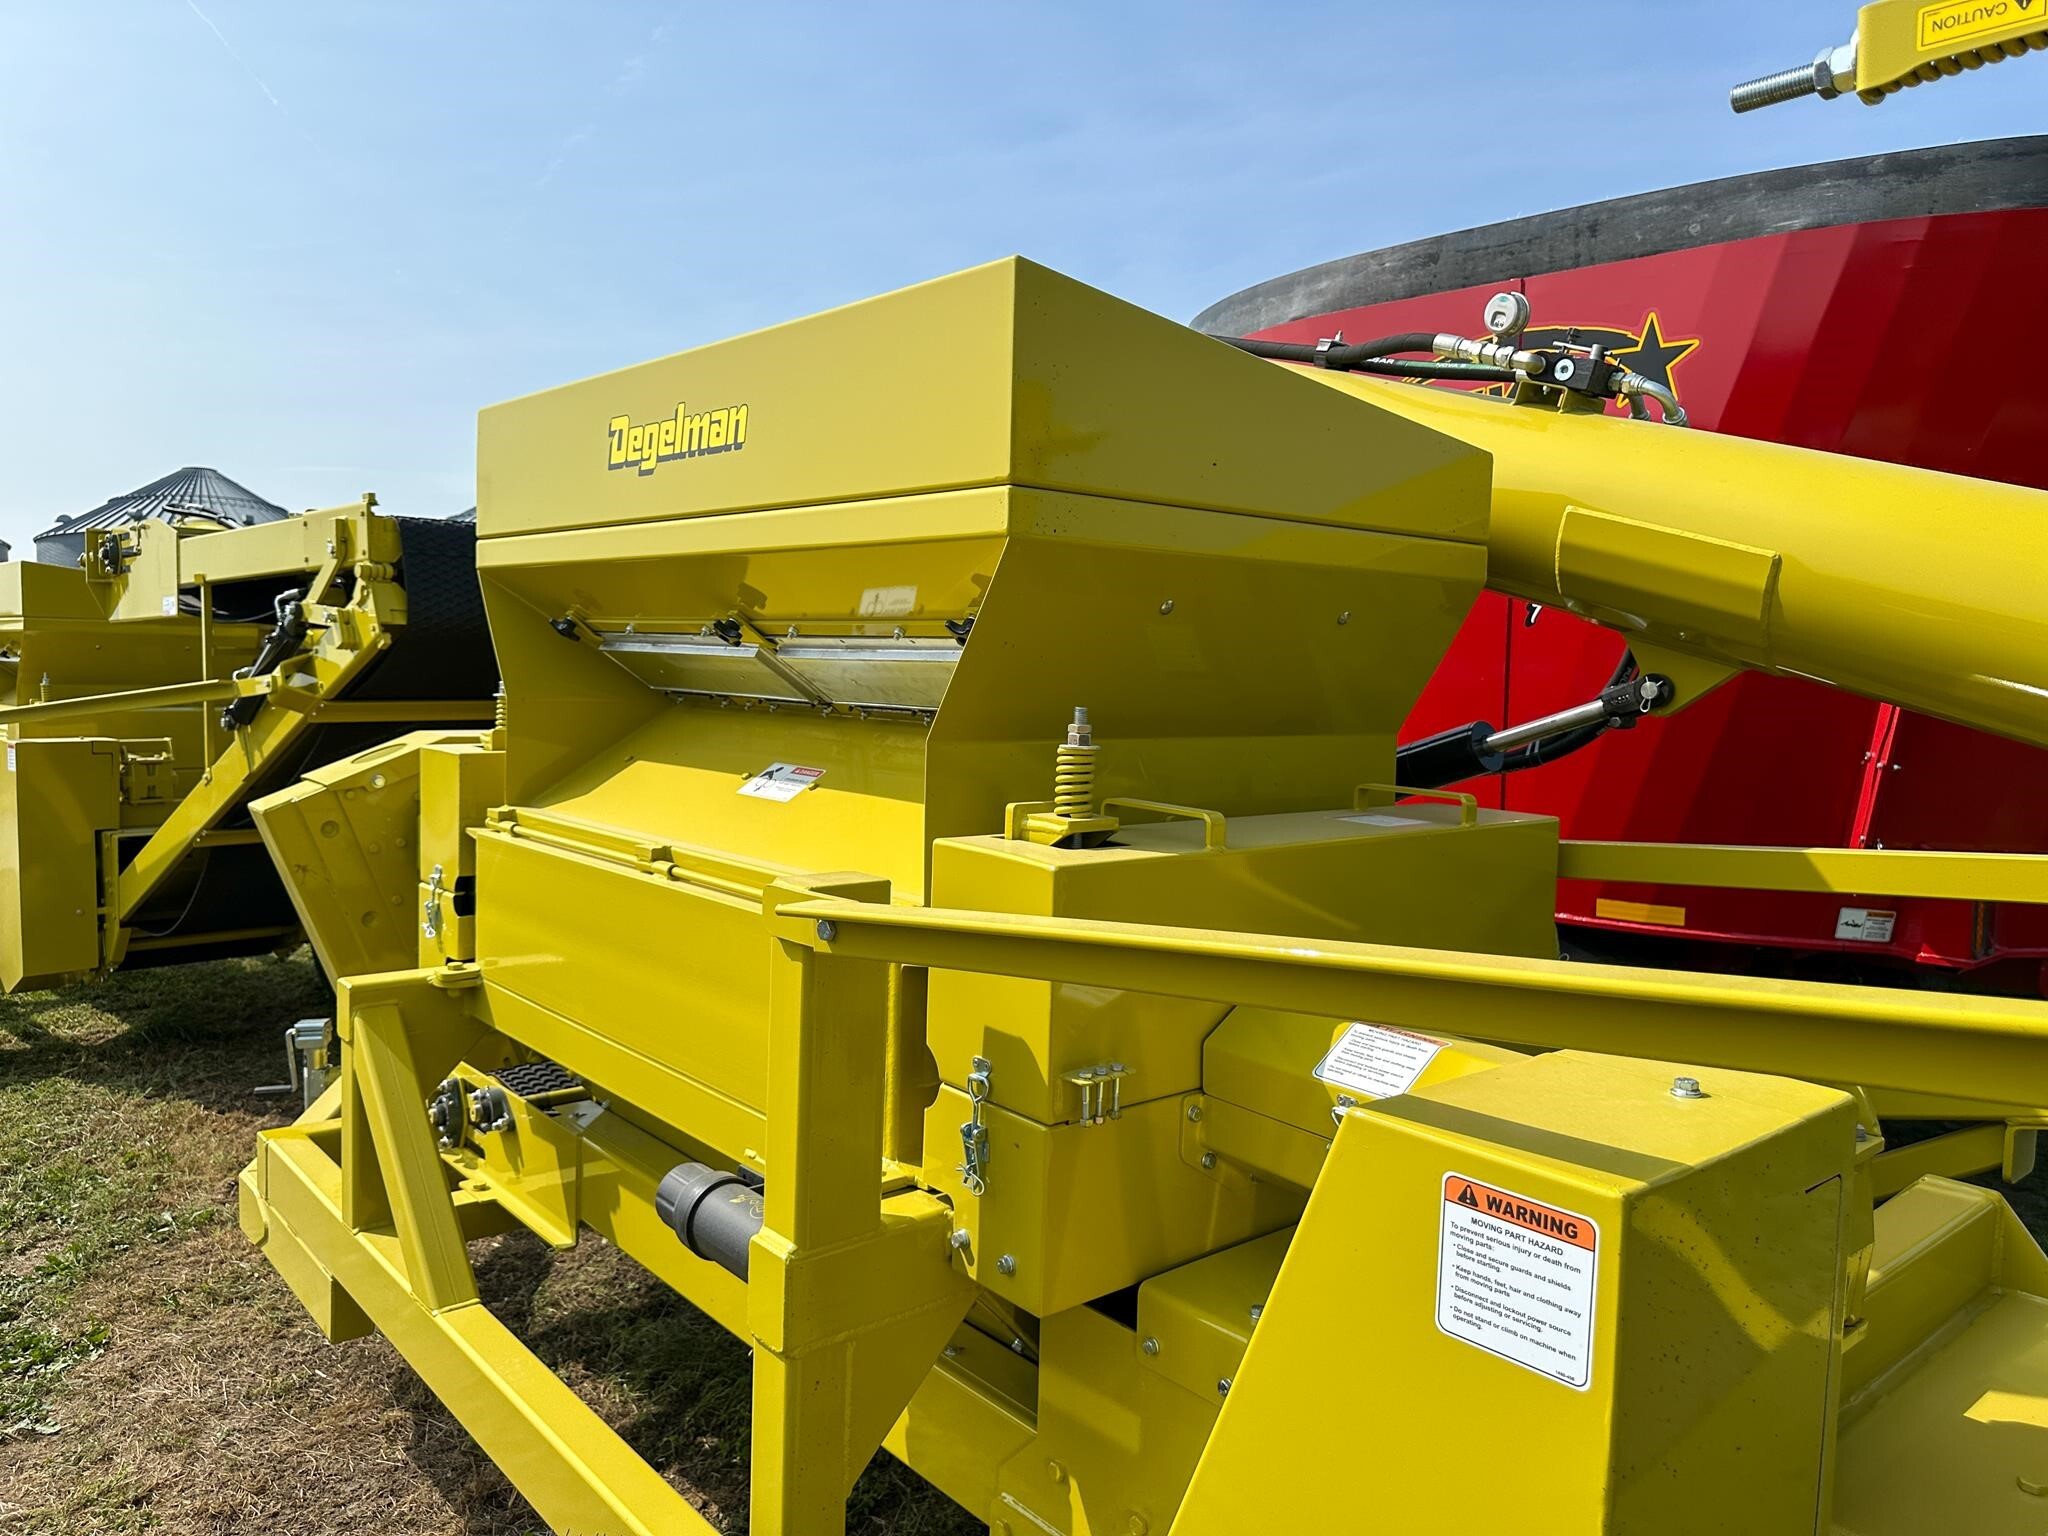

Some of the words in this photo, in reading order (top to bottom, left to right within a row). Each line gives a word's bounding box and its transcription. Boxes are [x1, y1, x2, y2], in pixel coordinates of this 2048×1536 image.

[1931, 2, 2008, 32] CAUTION
[608, 402, 749, 476] Degelman
[1450, 1231, 1474, 1245] moving
[1471, 1217, 1503, 1235] MOVING
[1504, 1229, 1526, 1243] PART
[1528, 1237, 1564, 1256] HAZARD
[1487, 1195, 1578, 1239] WARNING
[1451, 1221, 1459, 1230] To
[1460, 1226, 1485, 1239] prevent
[1486, 1235, 1511, 1249] serious
[1512, 1245, 1532, 1257] injury
[1542, 1256, 1563, 1267] death
[1564, 1262, 1581, 1274] from
[1456, 1250, 1475, 1262] before
[1457, 1244, 1474, 1255] Close
[1475, 1252, 1487, 1260] and
[1488, 1256, 1509, 1268] secure
[1510, 1265, 1532, 1277] guards
[1534, 1274, 1546, 1282] and
[1547, 1279, 1571, 1291] shields
[1455, 1271, 1469, 1281] from
[1470, 1278, 1493, 1292] moving
[1456, 1265, 1472, 1275] Keep
[1509, 1285, 1522, 1294] hair
[1523, 1292, 1535, 1300] and
[1536, 1297, 1563, 1312] clothing
[1564, 1308, 1582, 1319] away
[1454, 1292, 1473, 1304] before
[1475, 1302, 1503, 1317] adjusting
[1455, 1285, 1489, 1304] Disconnect
[1490, 1300, 1502, 1309] and
[1502, 1304, 1526, 1319] lockout
[1527, 1315, 1547, 1326] power
[1549, 1324, 1572, 1336] source
[1453, 1306, 1463, 1314] Do
[1463, 1311, 1474, 1319] not
[1475, 1316, 1492, 1326] stand
[1501, 1326, 1519, 1337] climb
[1529, 1338, 1557, 1353] machine
[1558, 1350, 1576, 1361] when
